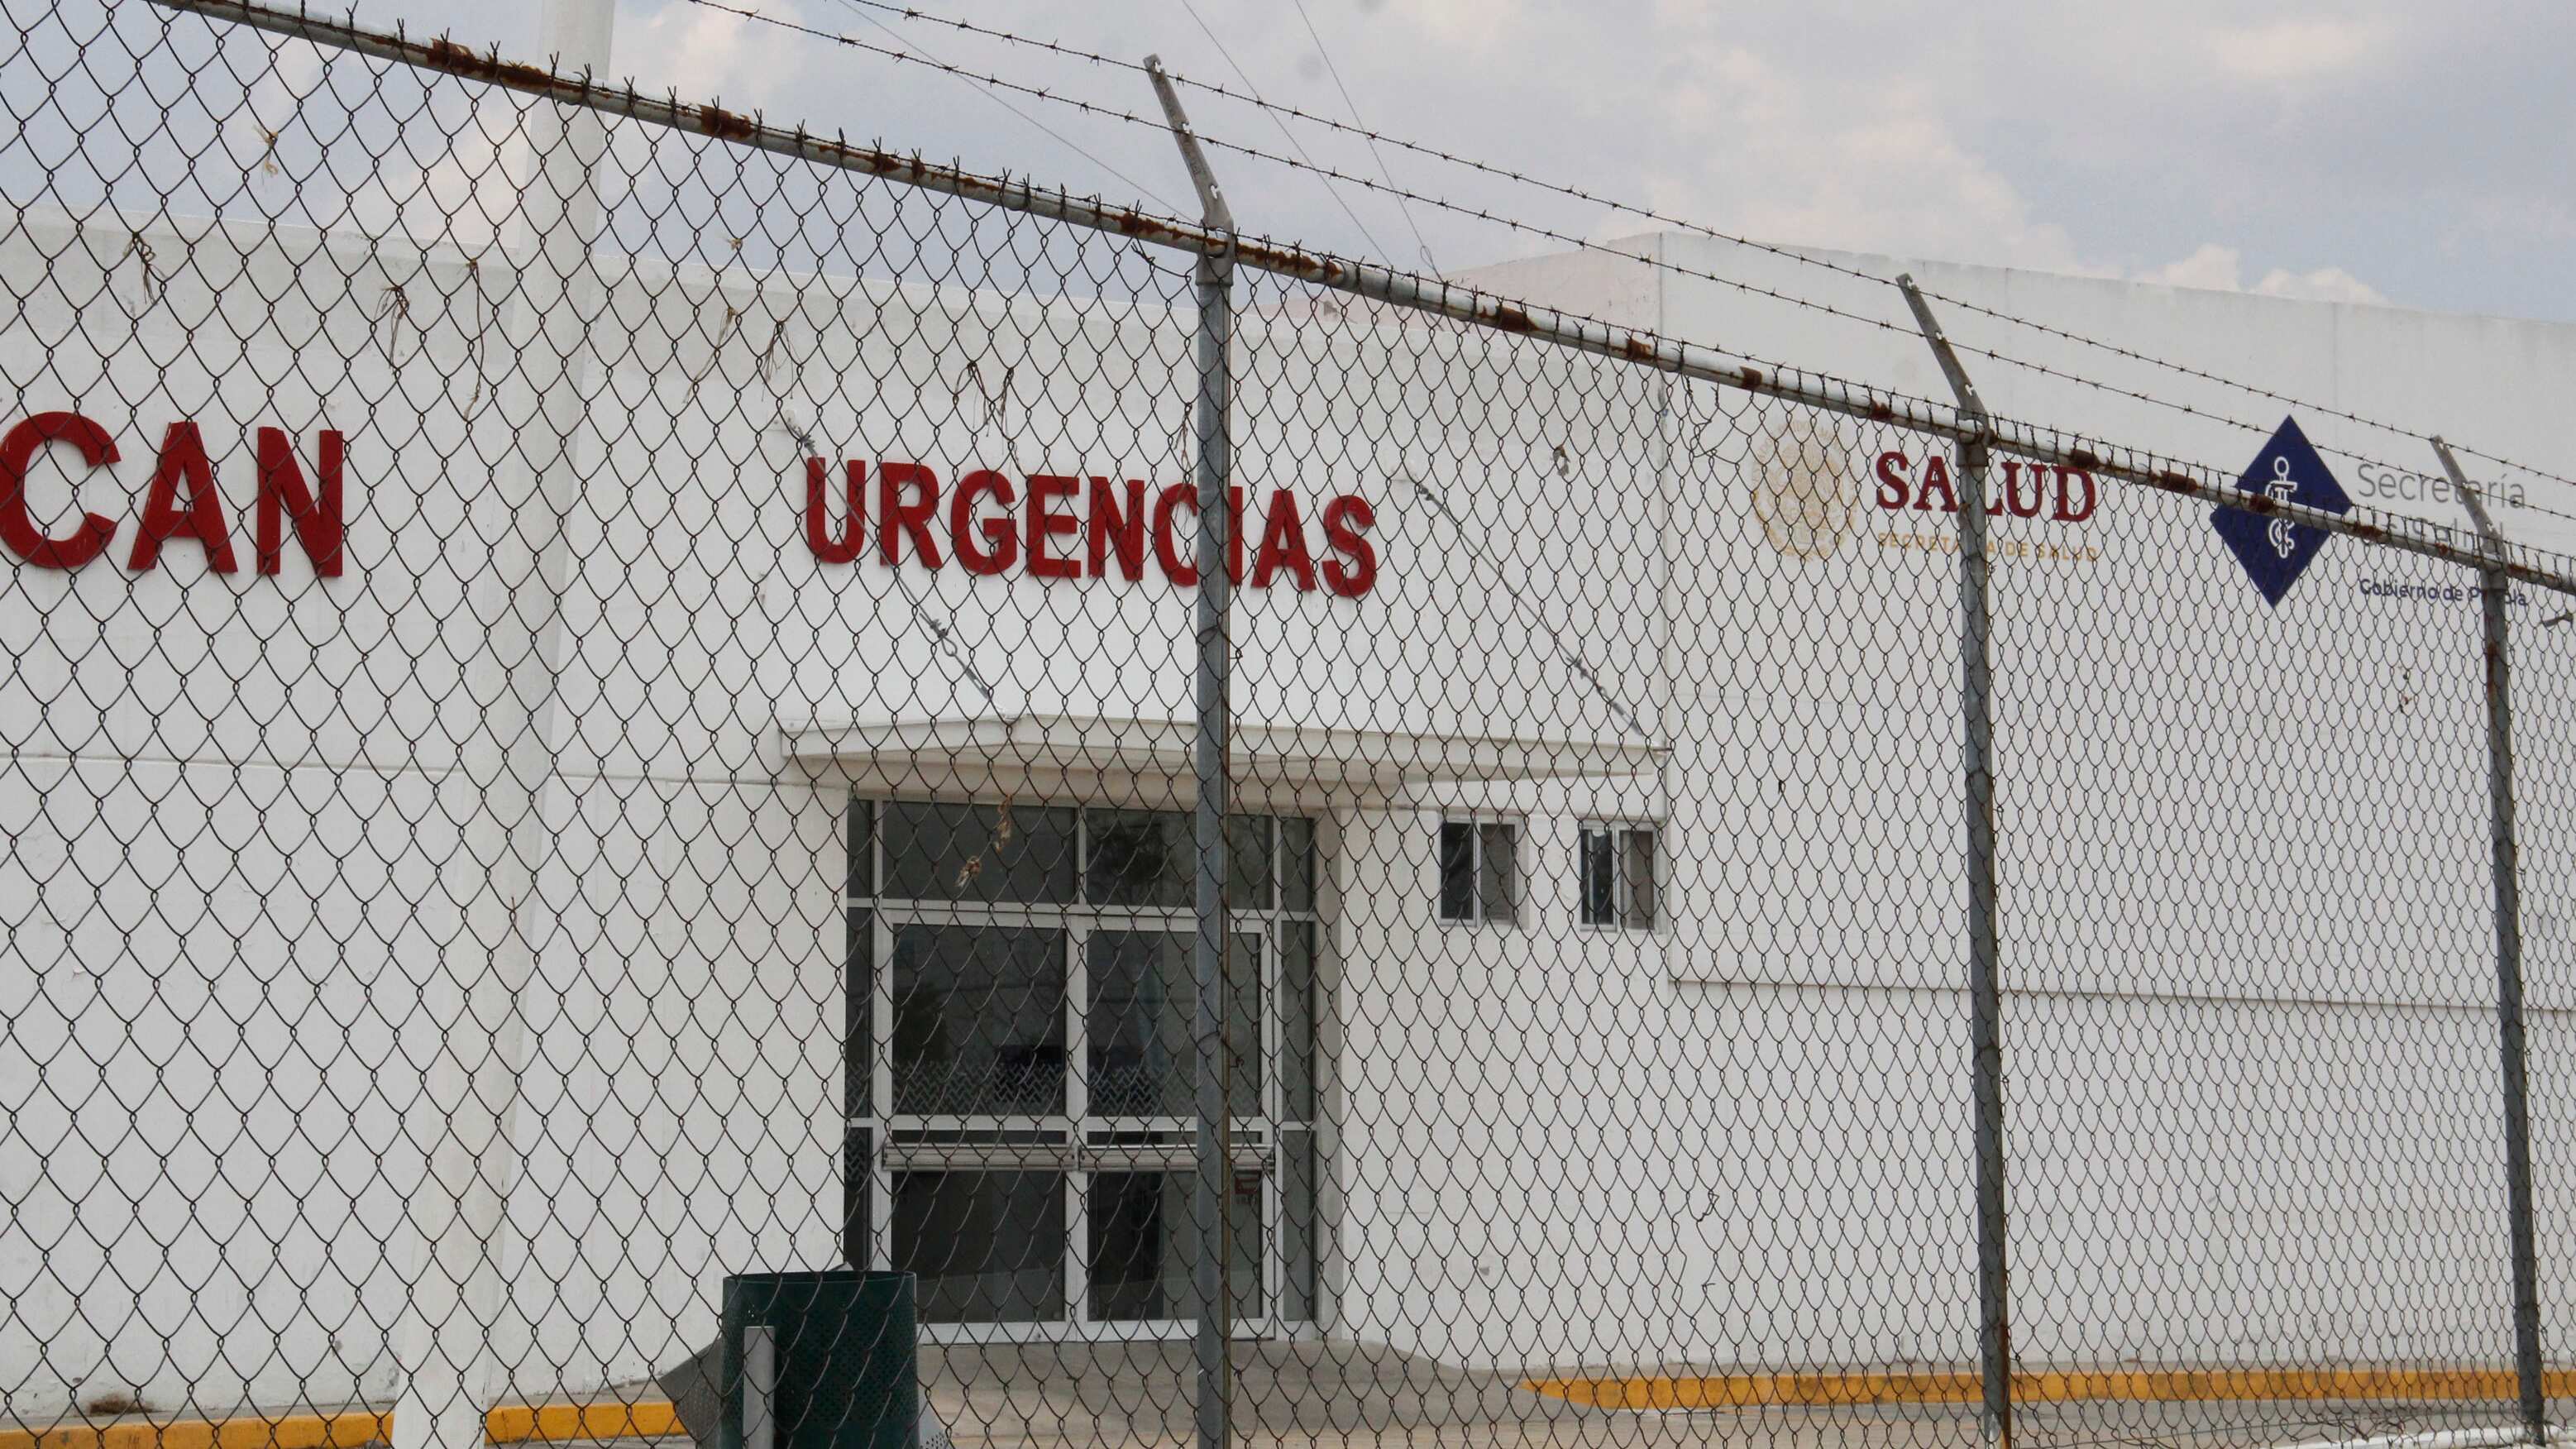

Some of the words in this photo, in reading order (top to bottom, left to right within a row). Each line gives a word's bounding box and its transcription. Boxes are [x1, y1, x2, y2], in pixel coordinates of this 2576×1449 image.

[0, 411, 343, 576] CAN
[805, 456, 1378, 598] URGENCIAS
[2005, 541, 2029, 557] DE
[2038, 543, 2097, 562] SALUD
[2359, 578, 2439, 600] Gobierno
[2442, 582, 2464, 600] de
